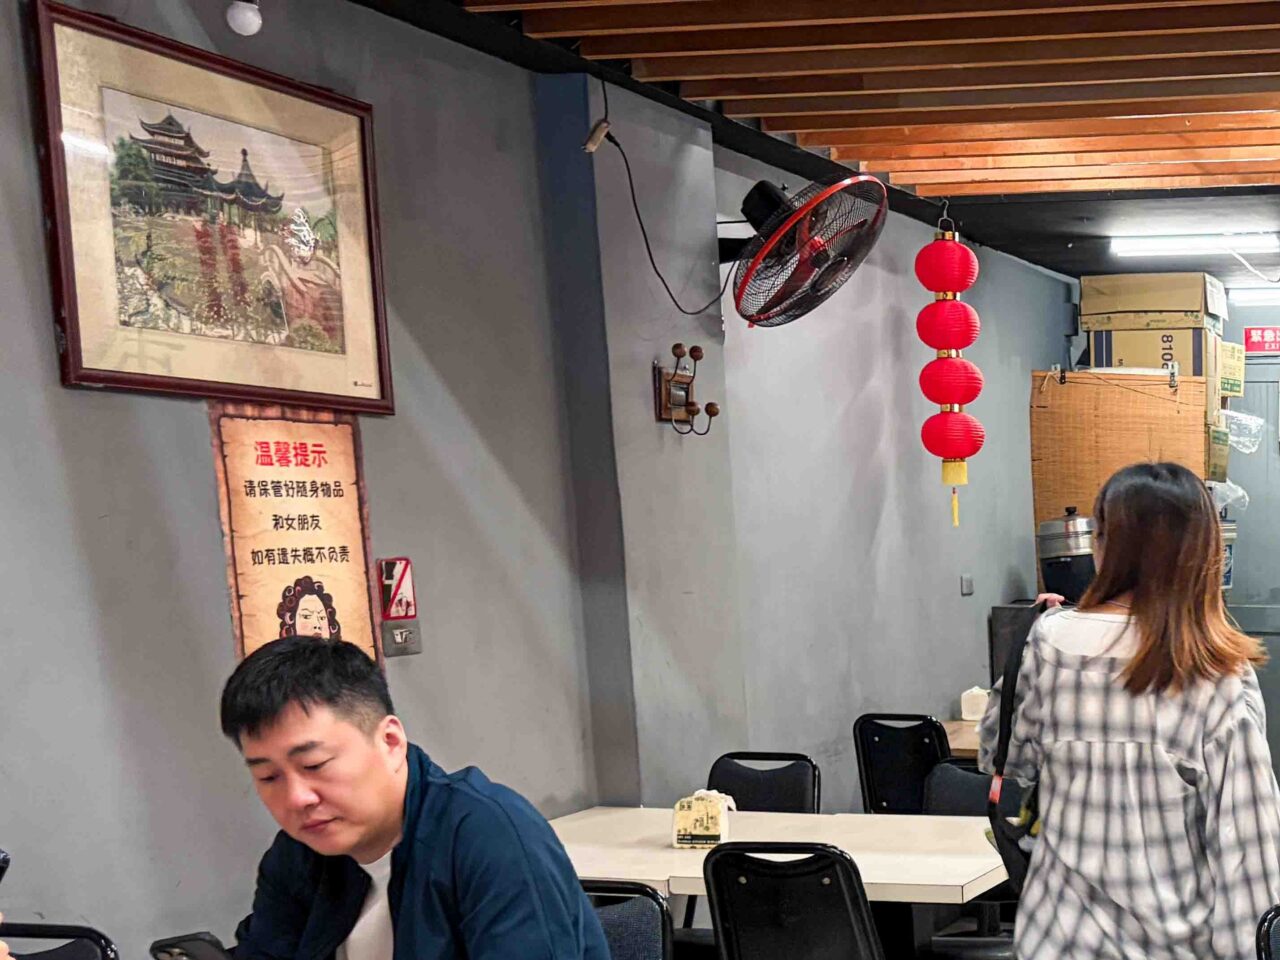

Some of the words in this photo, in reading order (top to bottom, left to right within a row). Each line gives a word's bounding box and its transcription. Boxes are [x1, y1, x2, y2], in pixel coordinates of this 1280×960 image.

[255, 441, 328, 468] 温馨提示
[243, 480, 344, 498] 请保管好随身物品
[272, 514, 322, 531] 和女朋友
[251, 546, 350, 566] 如有遗失概不负责
